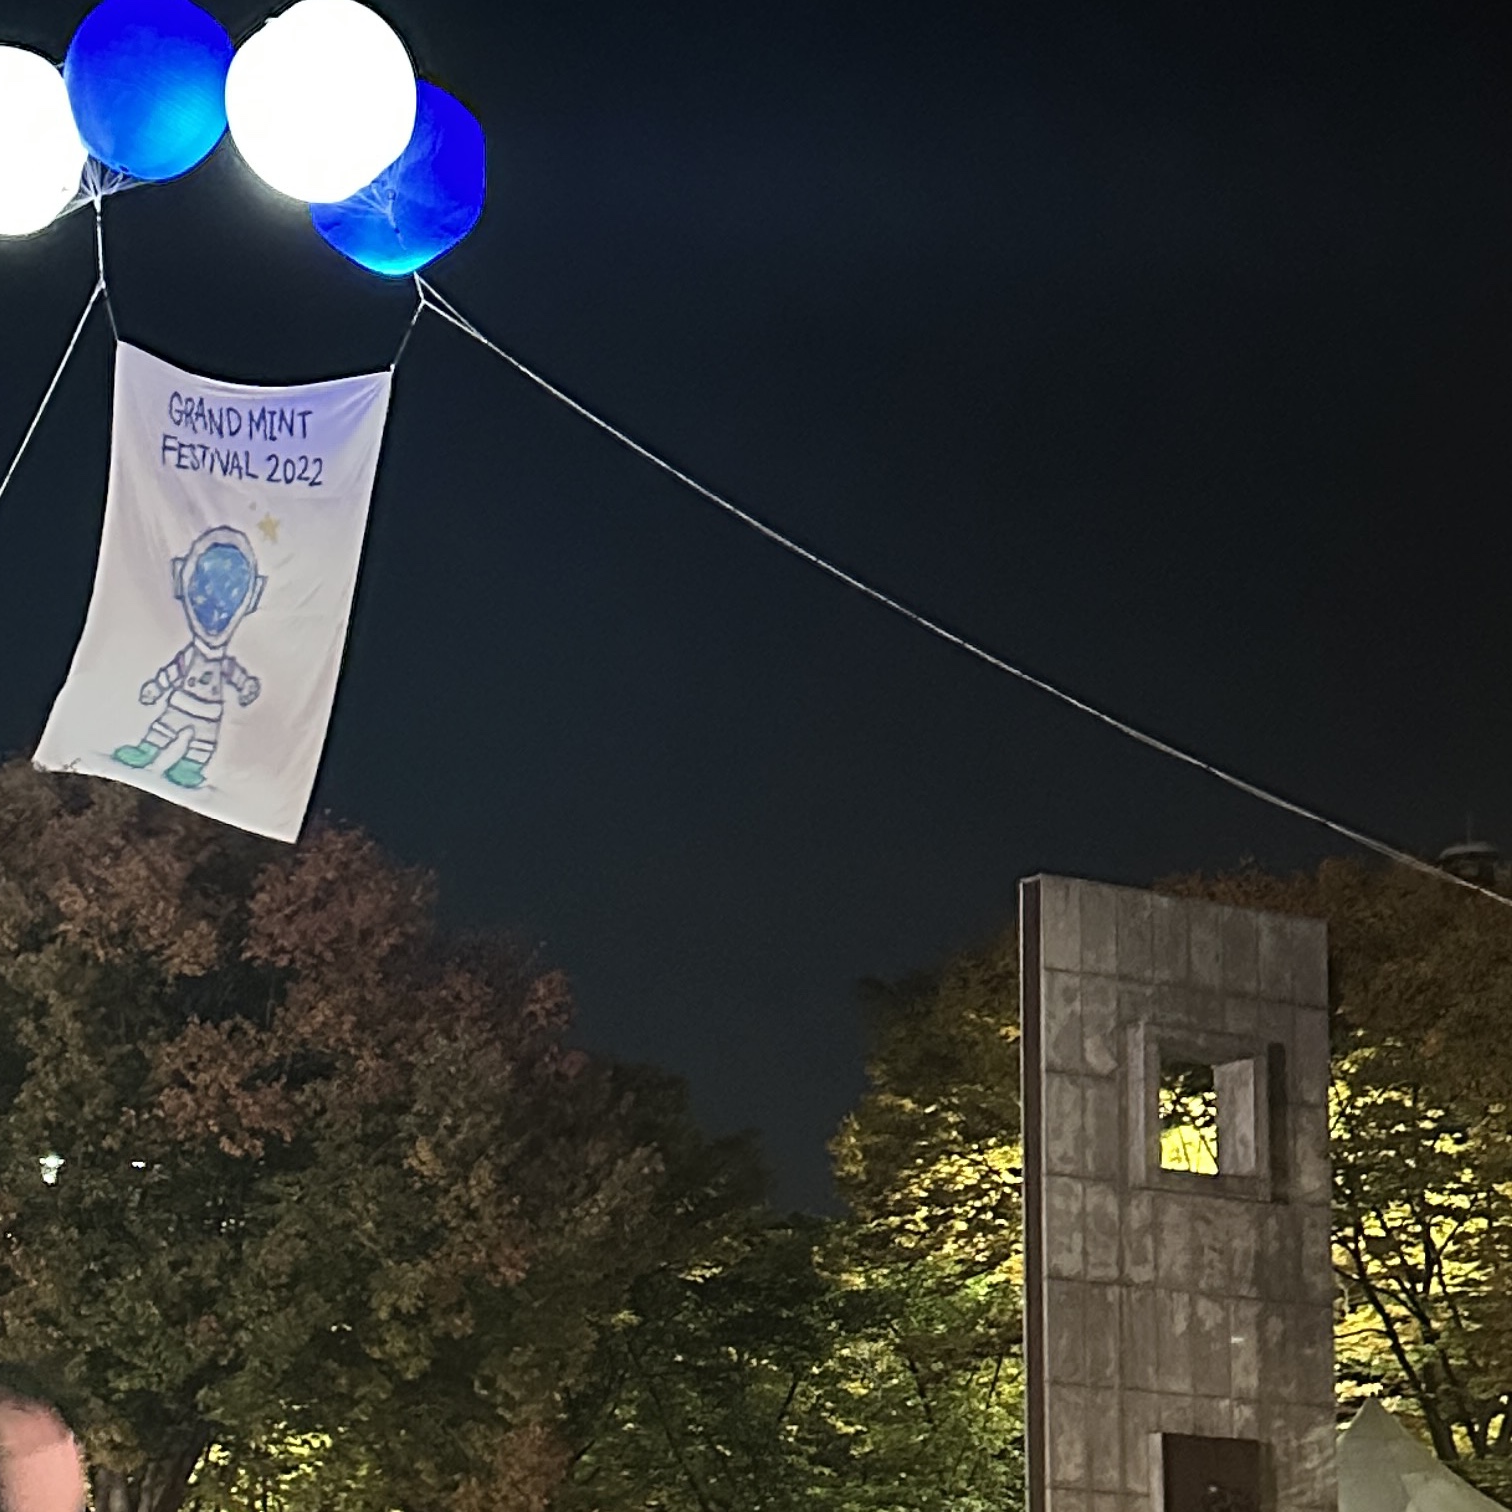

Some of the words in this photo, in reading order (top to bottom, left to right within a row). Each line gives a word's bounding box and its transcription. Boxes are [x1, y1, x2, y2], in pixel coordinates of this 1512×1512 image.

[169, 391, 242, 438] GRAND
[248, 406, 313, 441] MINT
[162, 434, 258, 480] FESTIVAL
[266, 454, 323, 486] 2022
